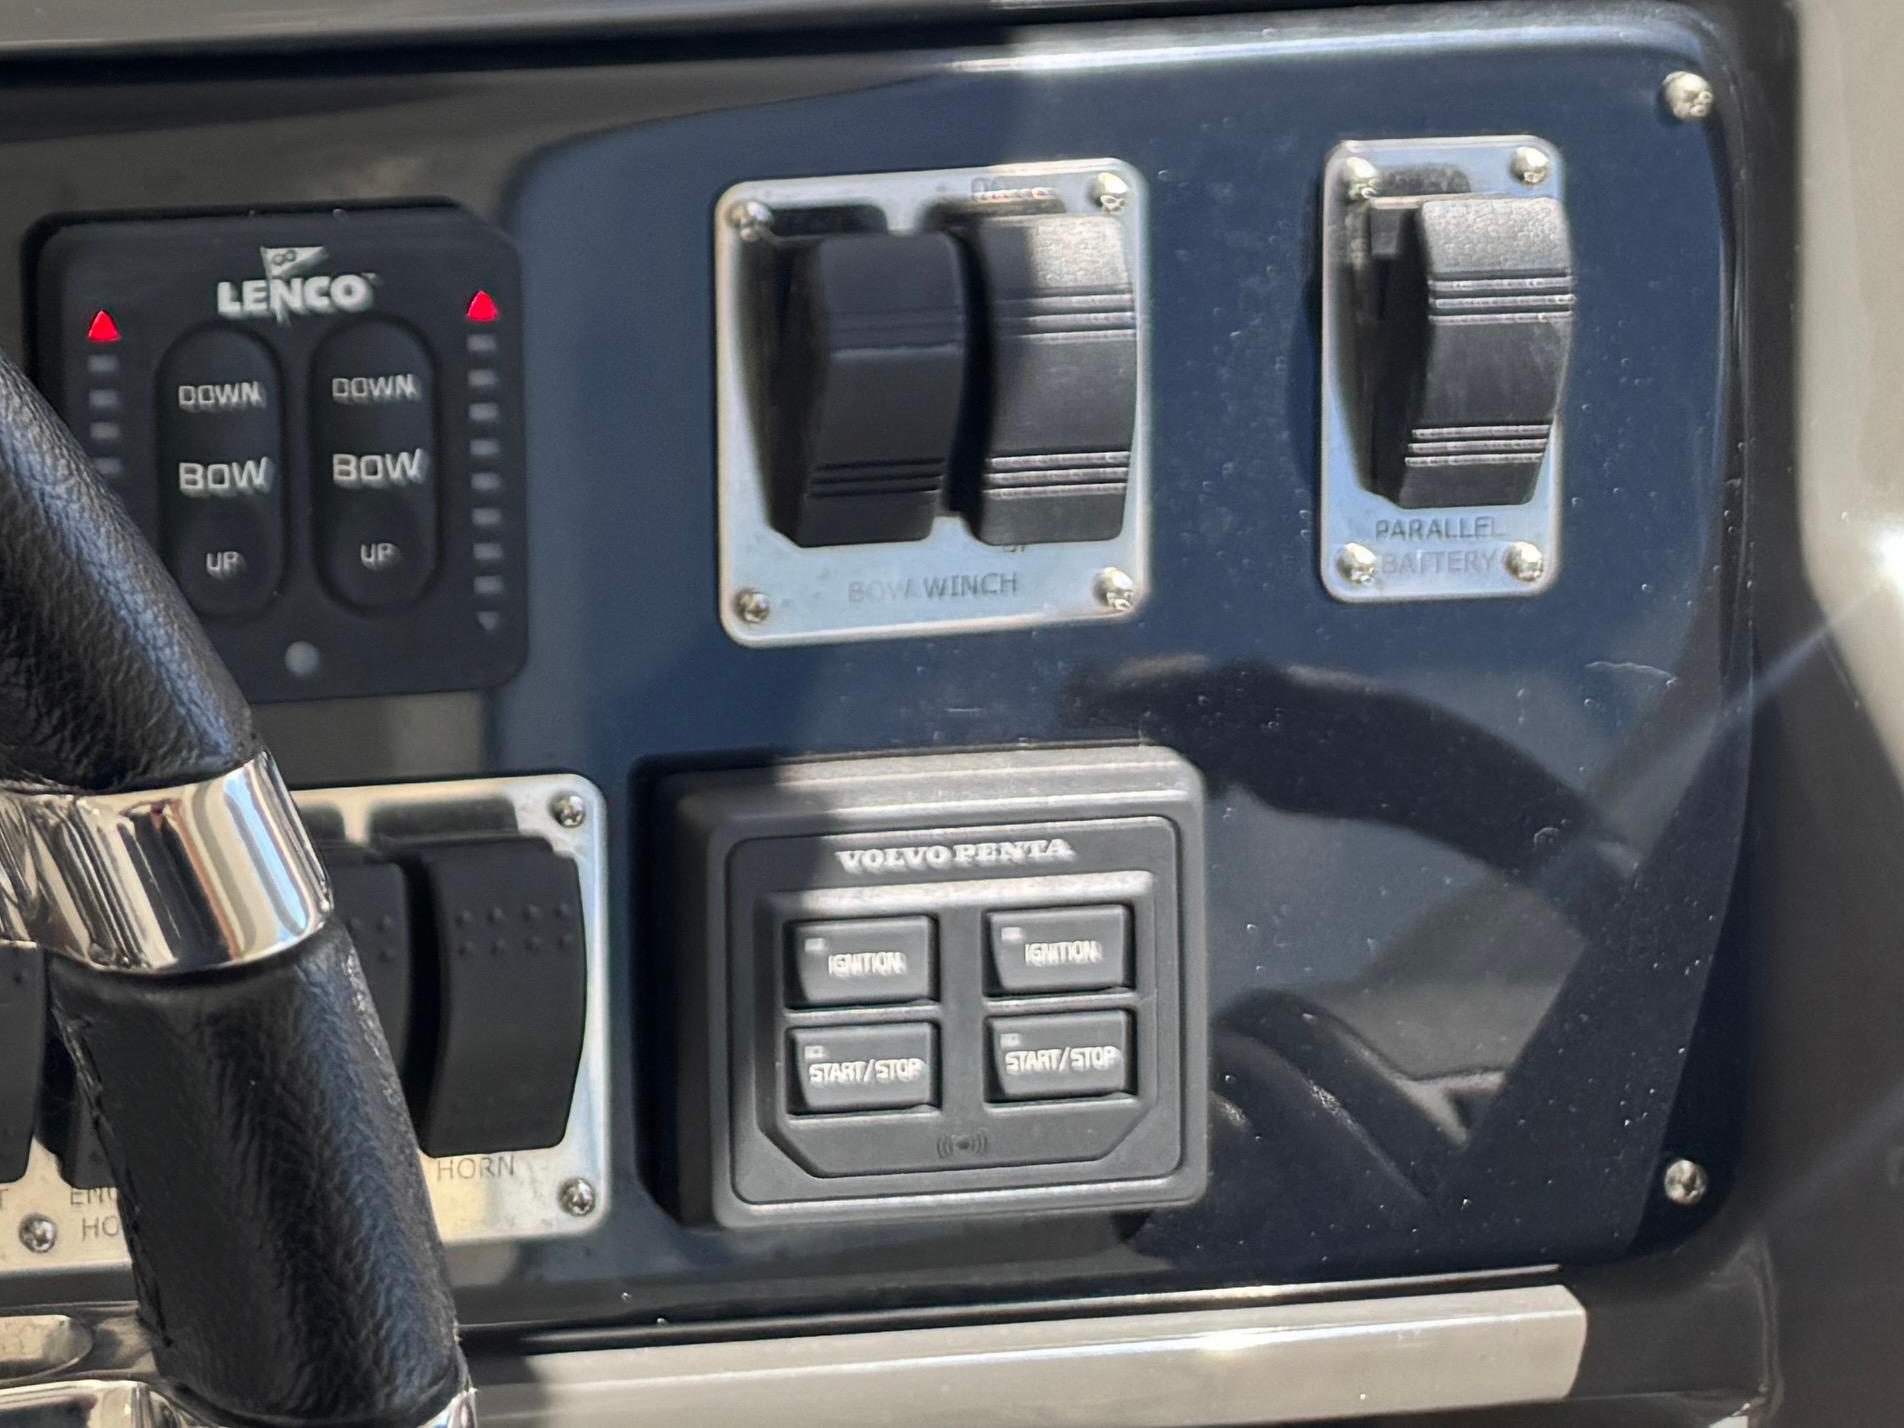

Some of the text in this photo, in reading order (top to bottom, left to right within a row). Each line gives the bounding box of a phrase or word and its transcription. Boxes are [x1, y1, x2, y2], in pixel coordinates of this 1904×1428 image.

[217, 273, 373, 321] LENCO
[178, 381, 268, 413] DOWN
[332, 373, 422, 405] DOWN
[178, 456, 275, 497] BOW
[333, 448, 430, 487] BOW
[1375, 515, 1507, 541] PARALLEL
[205, 550, 247, 580] UP
[360, 542, 400, 571] UP
[1380, 548, 1498, 575] BATTERY
[923, 571, 1018, 602] WINCH
[835, 838, 1076, 875] VOLVO PENTA
[827, 951, 907, 978] IGNITION
[1024, 940, 1102, 967] IGNITION
[808, 1058, 928, 1087] START/STOP
[1004, 1046, 1125, 1075] START/STOP
[436, 1155, 516, 1181] HORN
